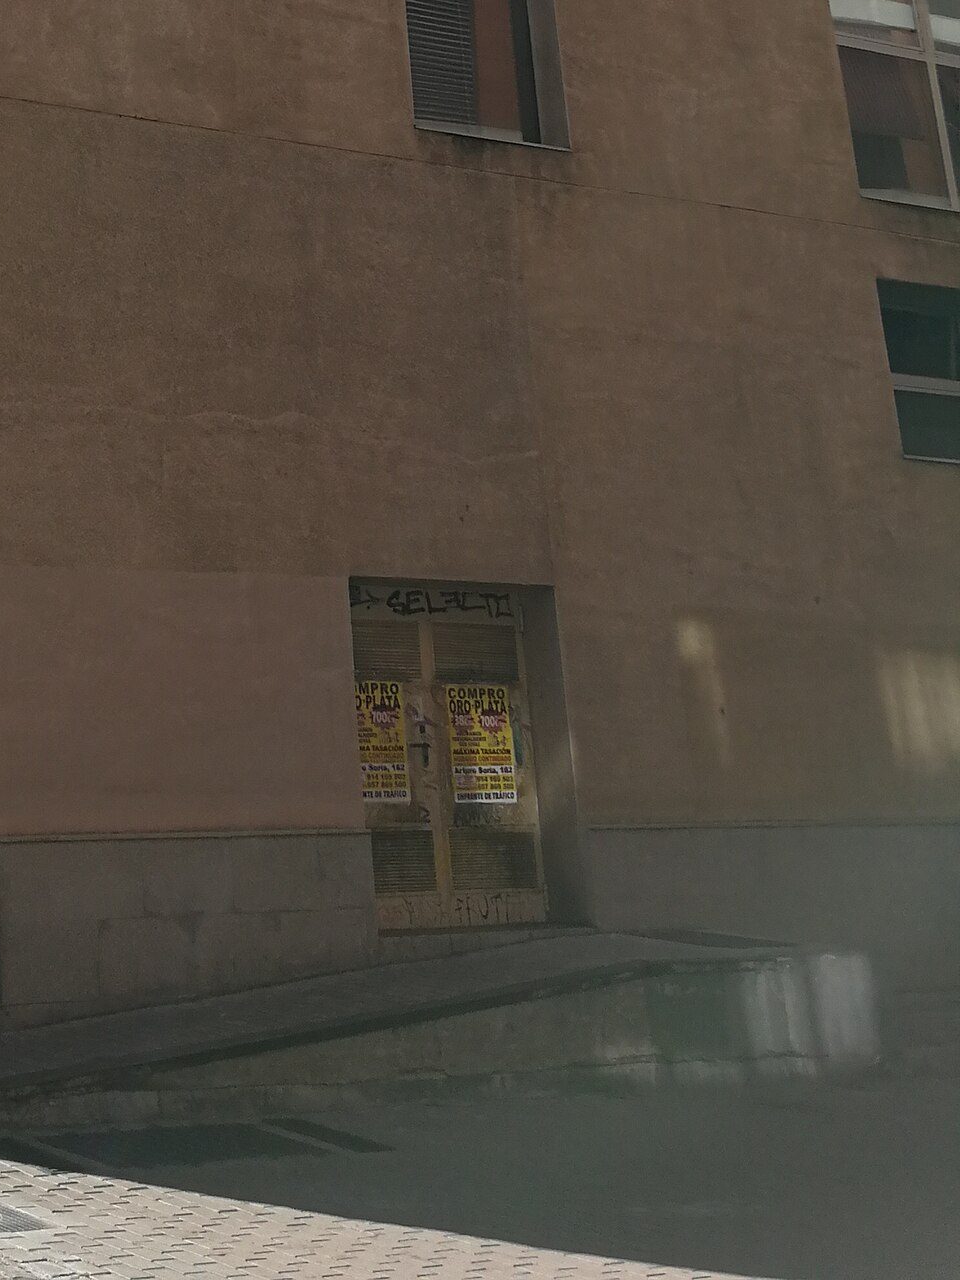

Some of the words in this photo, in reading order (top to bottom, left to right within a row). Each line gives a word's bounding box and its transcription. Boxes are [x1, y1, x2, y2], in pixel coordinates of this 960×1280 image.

[448, 687, 505, 700] COMPRO
[366, 695, 401, 710] PLATA
[449, 699, 471, 714] ORO
[474, 699, 507, 714] PLATA
[492, 791, 515, 800] TRÁFICO
